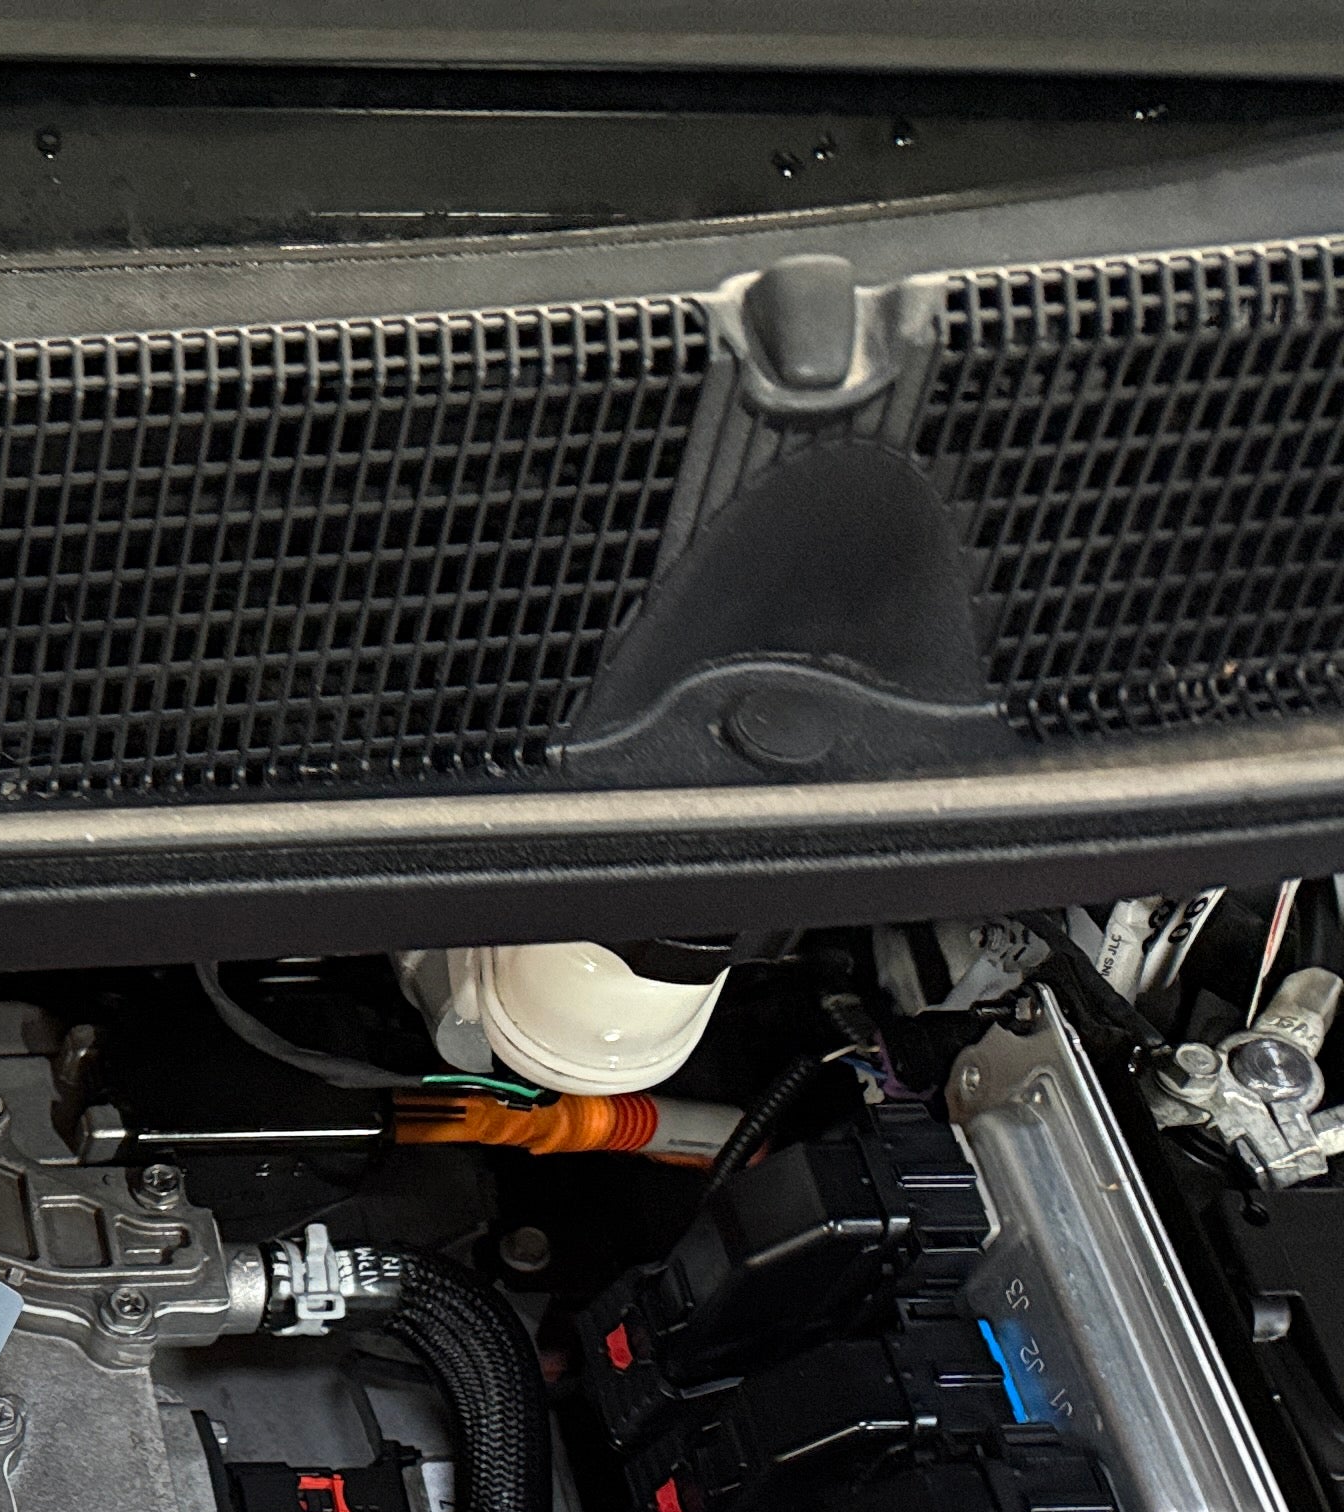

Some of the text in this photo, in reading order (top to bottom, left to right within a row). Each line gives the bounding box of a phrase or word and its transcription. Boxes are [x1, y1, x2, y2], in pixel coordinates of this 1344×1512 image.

[1111, 934, 1122, 955] JLC
[1006, 1278, 1030, 1310] J3
[1020, 1337, 1045, 1373] J2
[1050, 1389, 1073, 1416] J1
